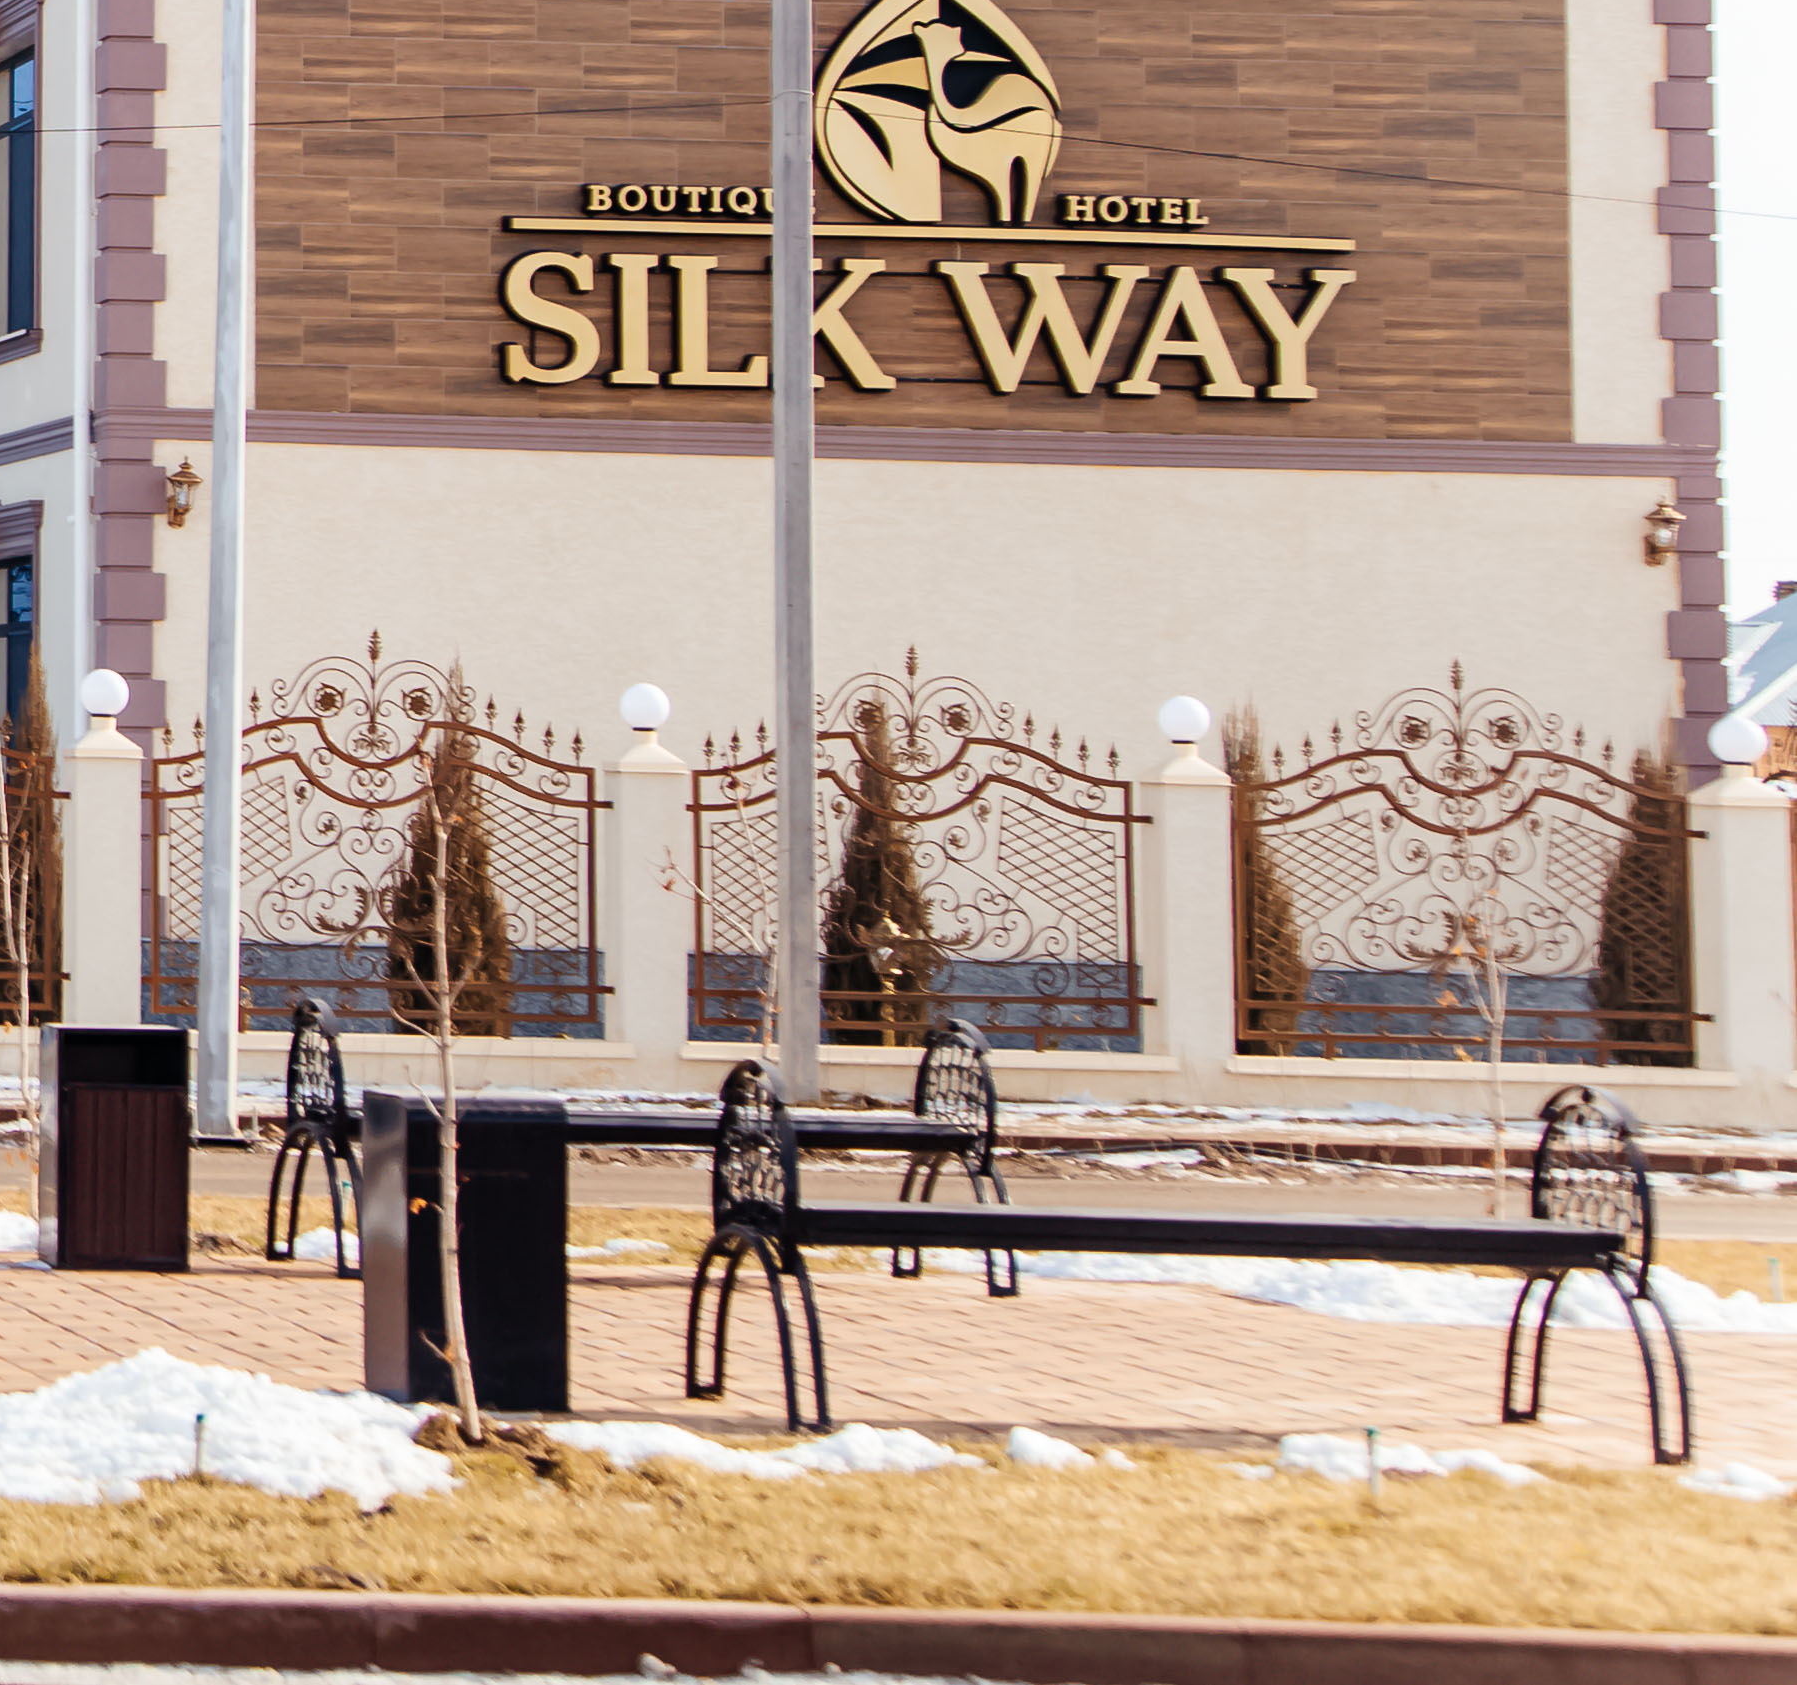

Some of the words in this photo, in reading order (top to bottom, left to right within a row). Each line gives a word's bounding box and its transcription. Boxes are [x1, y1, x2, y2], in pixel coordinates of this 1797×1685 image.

[586, 184, 816, 216] BOUTIQ
[1063, 195, 1210, 225] HOTEL
[505, 251, 897, 390] SILK
[935, 261, 1357, 399] WAY
